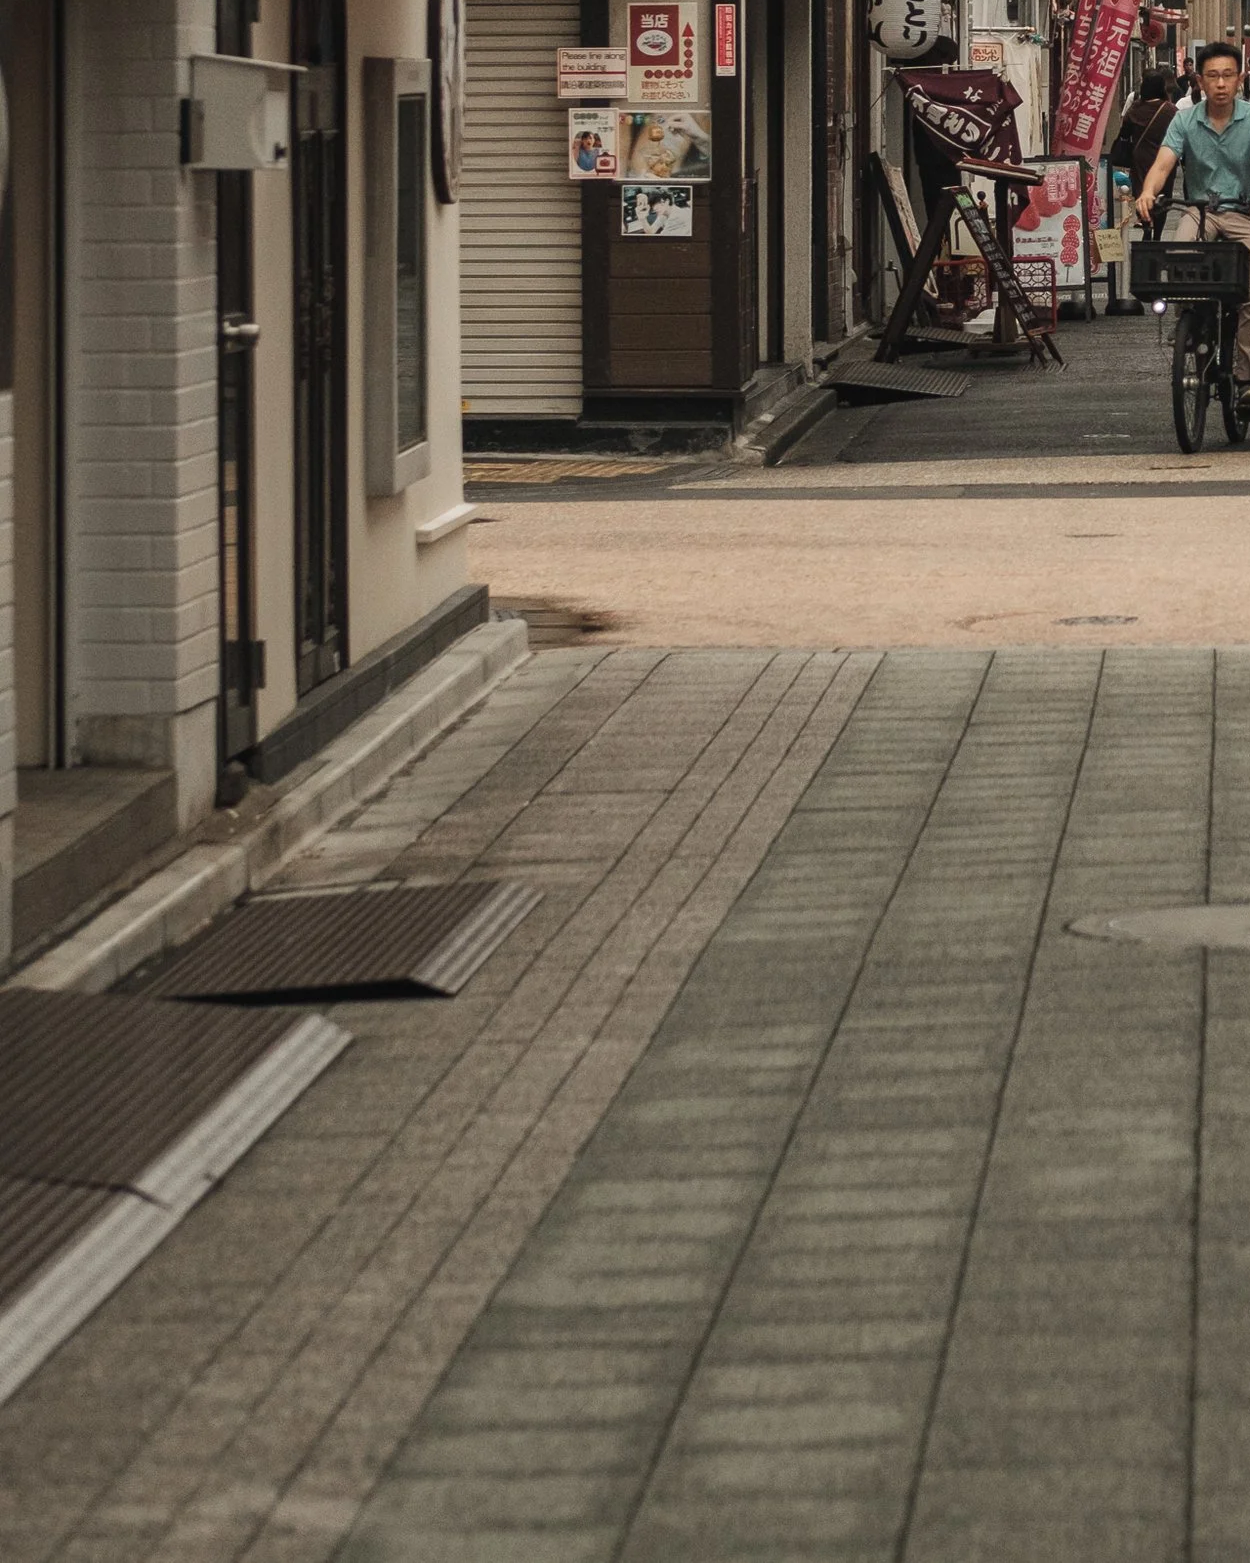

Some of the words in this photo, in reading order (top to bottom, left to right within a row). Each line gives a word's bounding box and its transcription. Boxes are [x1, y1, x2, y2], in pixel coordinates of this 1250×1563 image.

[641, 14, 669, 29] 当店
[562, 52, 587, 60] Please
[589, 52, 602, 60] line
[605, 52, 626, 61] along
[562, 63, 576, 71] the
[577, 63, 607, 72] building
[1072, 17, 1132, 142] 元祖浅草
[641, 81, 685, 89] 建物にそって
[641, 91, 691, 100] お並びください
